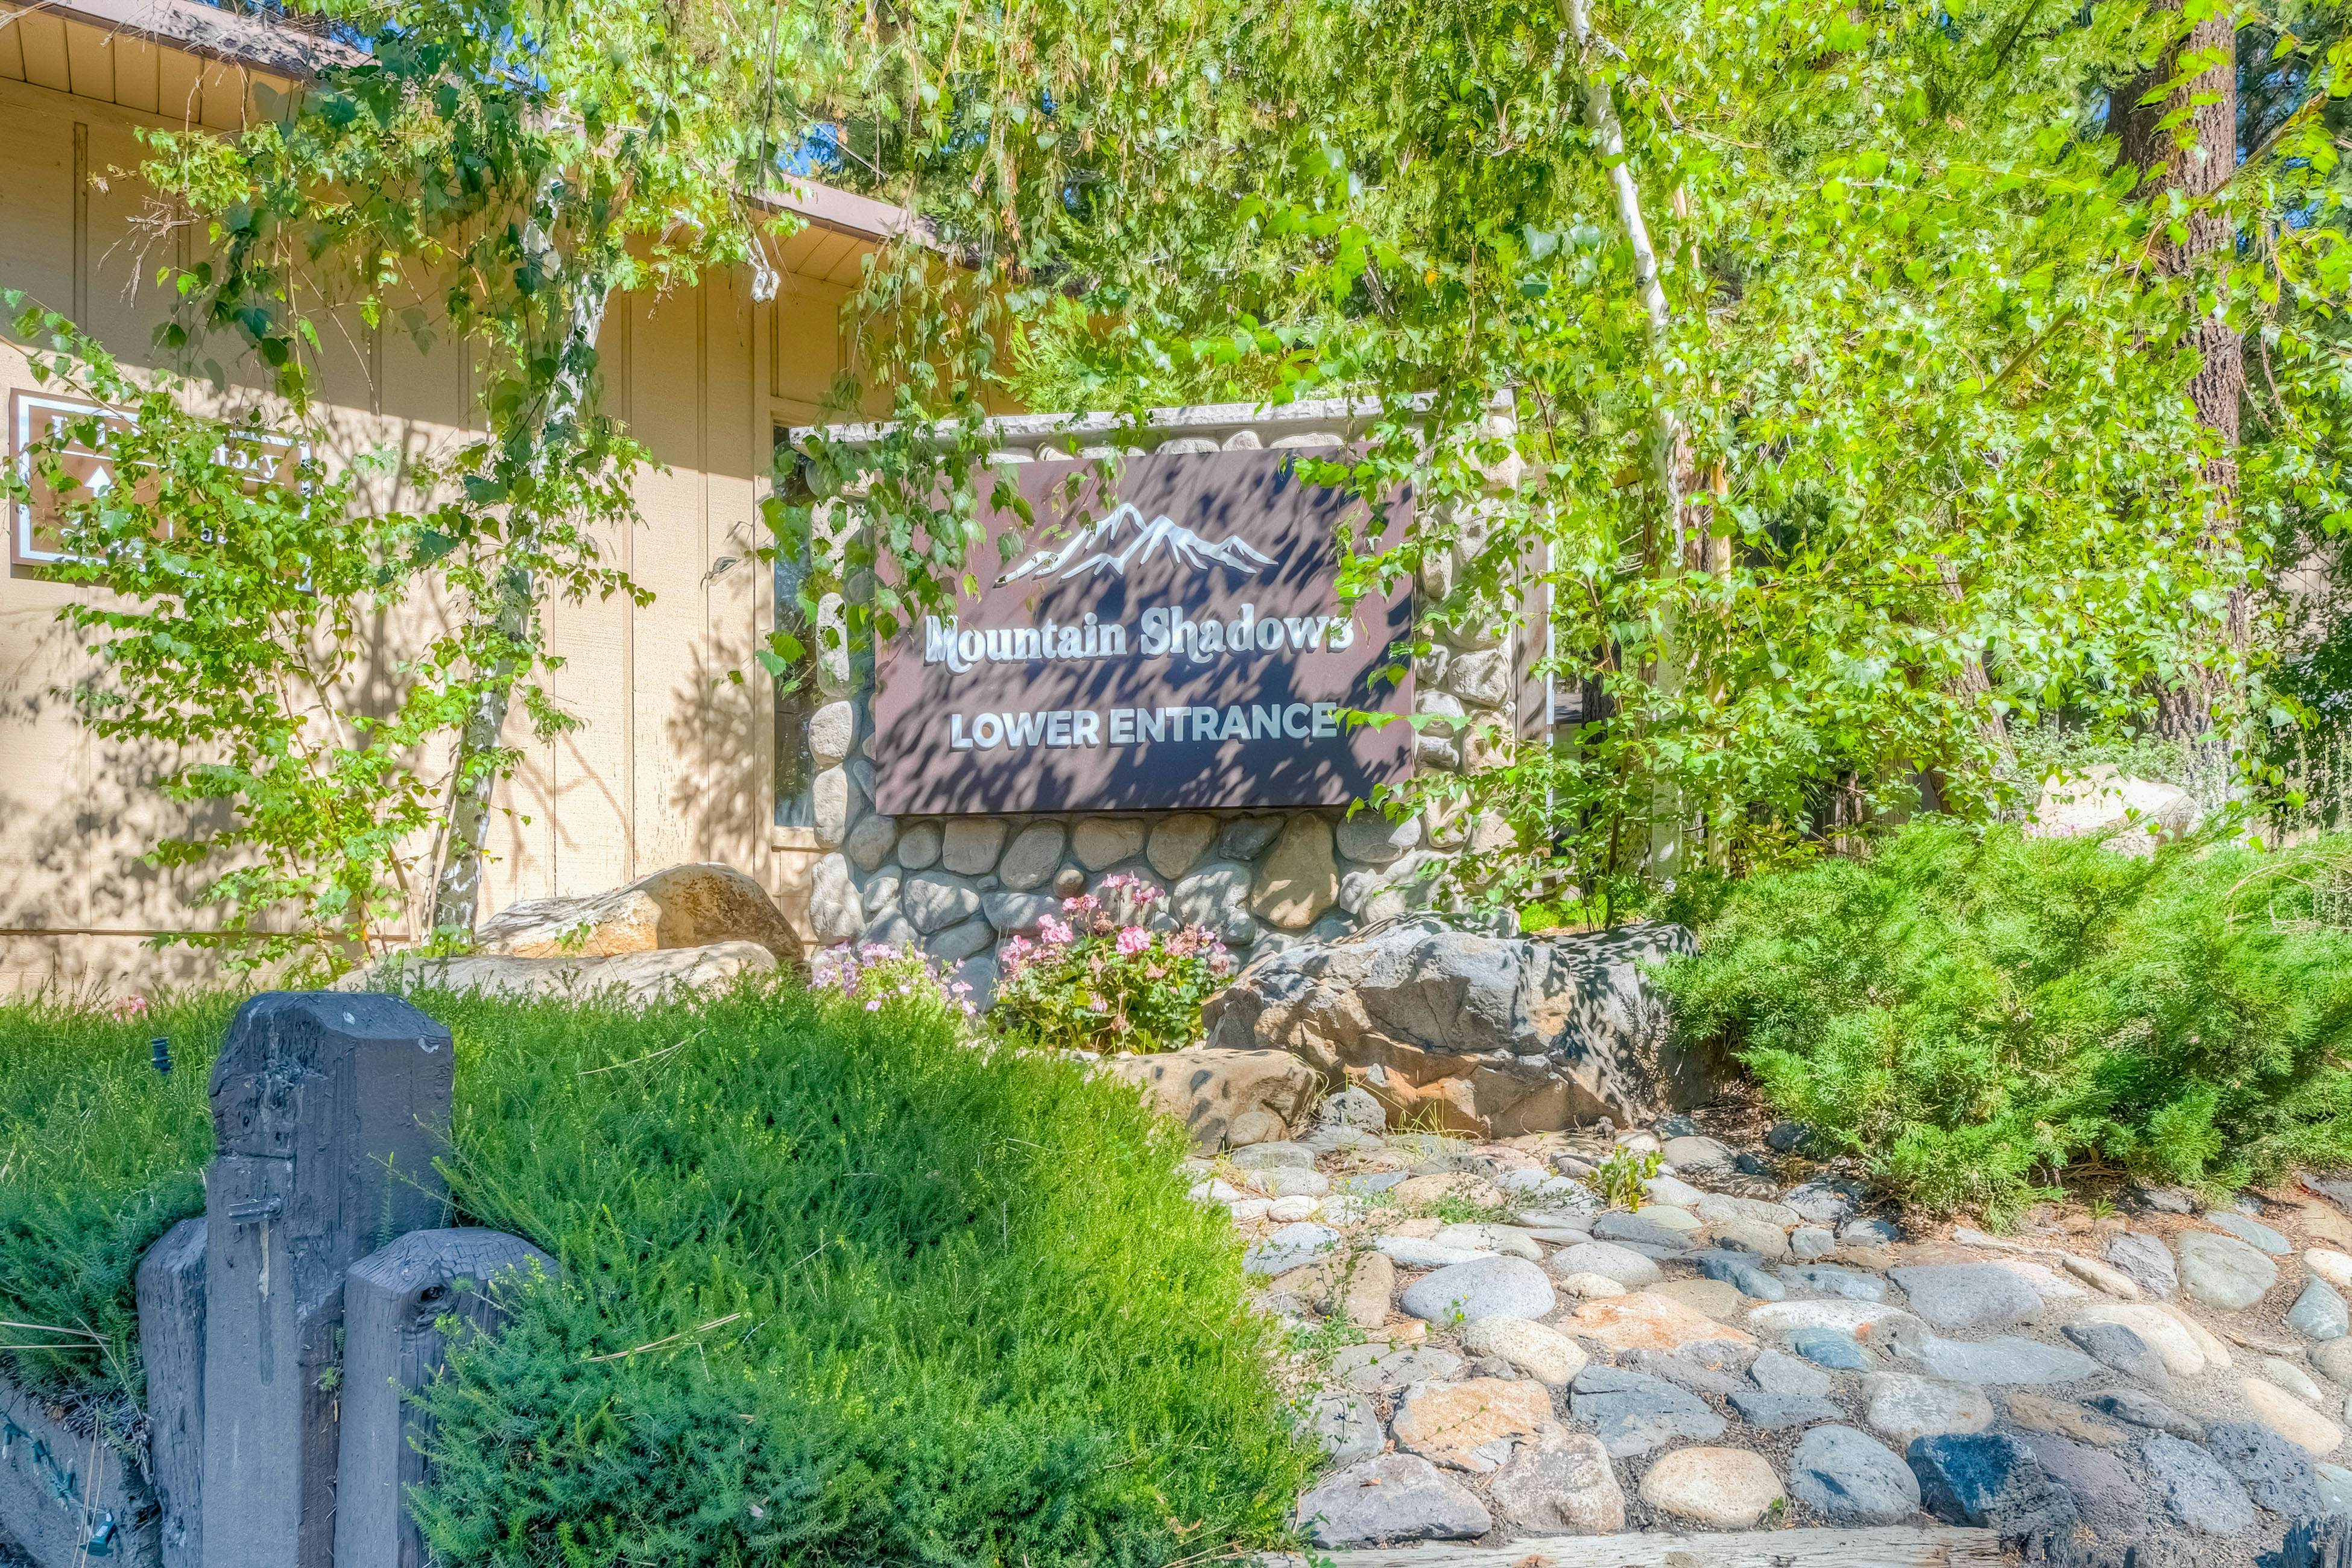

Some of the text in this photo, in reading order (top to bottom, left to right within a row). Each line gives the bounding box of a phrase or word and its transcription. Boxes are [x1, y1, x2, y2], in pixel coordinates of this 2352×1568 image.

[925, 603, 1355, 674] Mountain Shadows
[951, 702, 1338, 748] LOWER ENTRANCE
